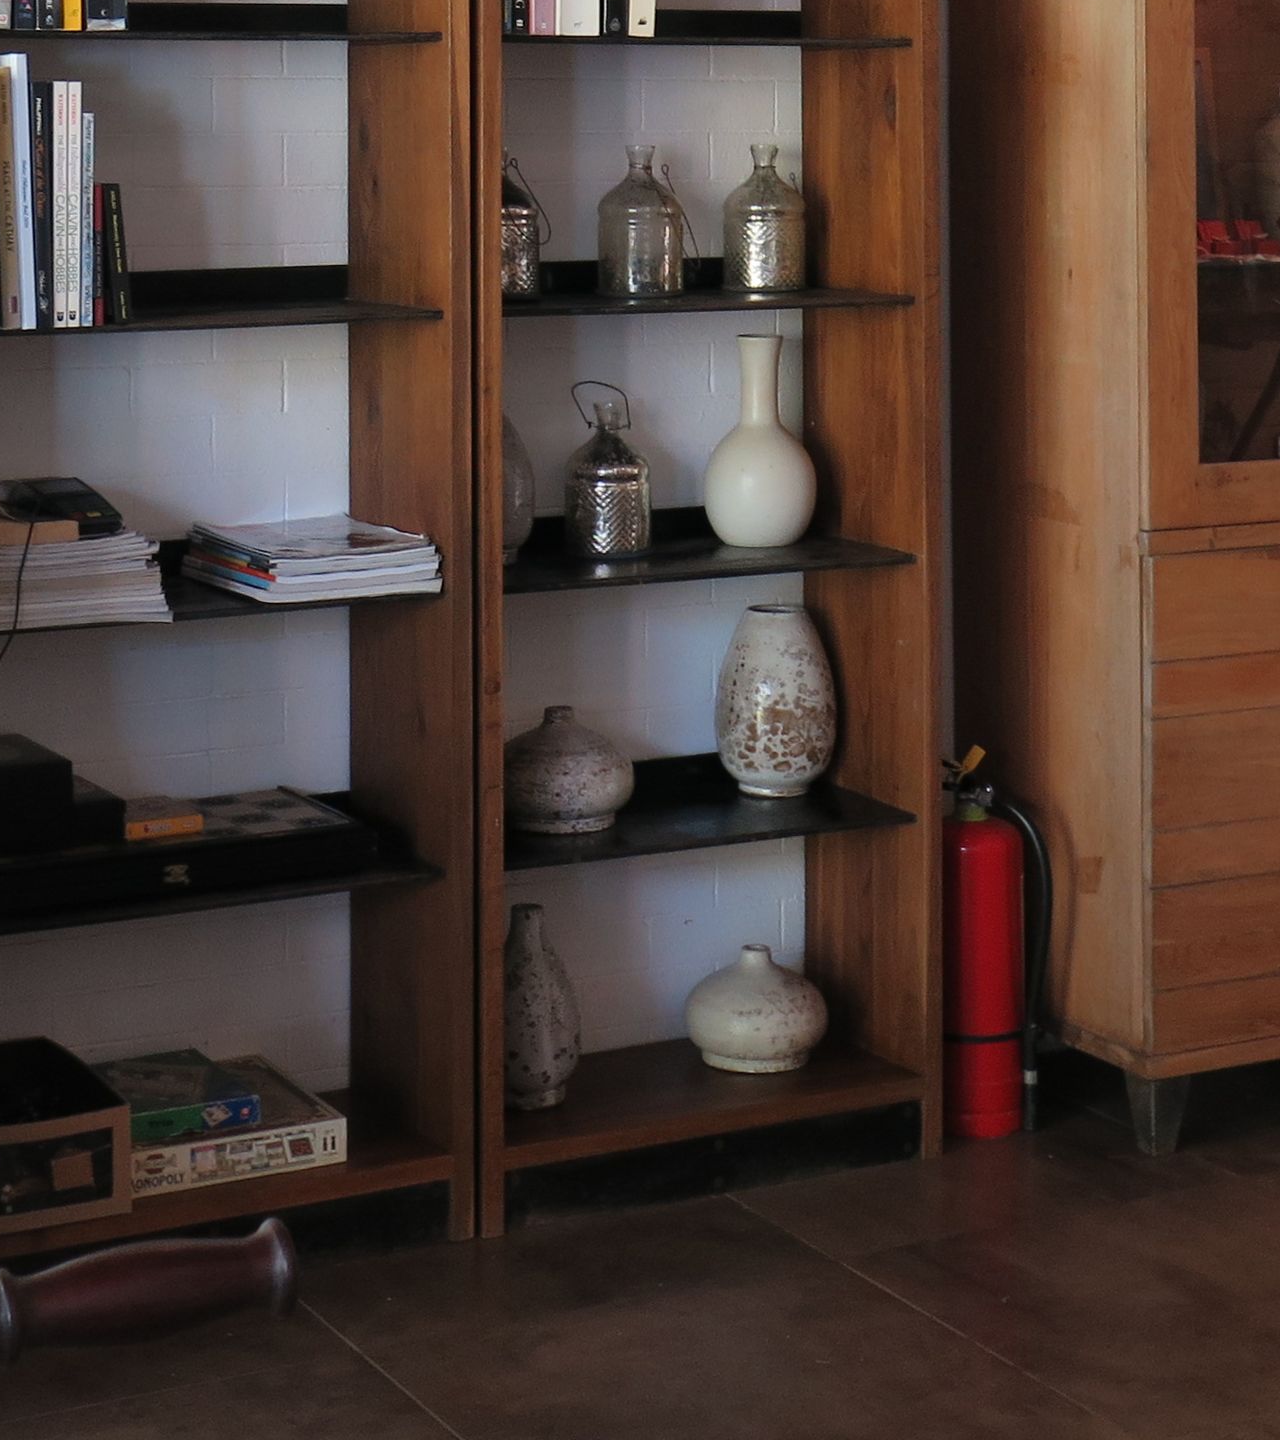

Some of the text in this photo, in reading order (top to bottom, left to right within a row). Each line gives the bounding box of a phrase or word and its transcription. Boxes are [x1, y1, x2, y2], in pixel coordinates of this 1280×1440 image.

[5, 215, 15, 253] CATHAY
[55, 194, 66, 237] CALVIN
[68, 194, 78, 236] CALVIN
[56, 249, 66, 294] HOBBES
[68, 248, 78, 292] HOBBES
